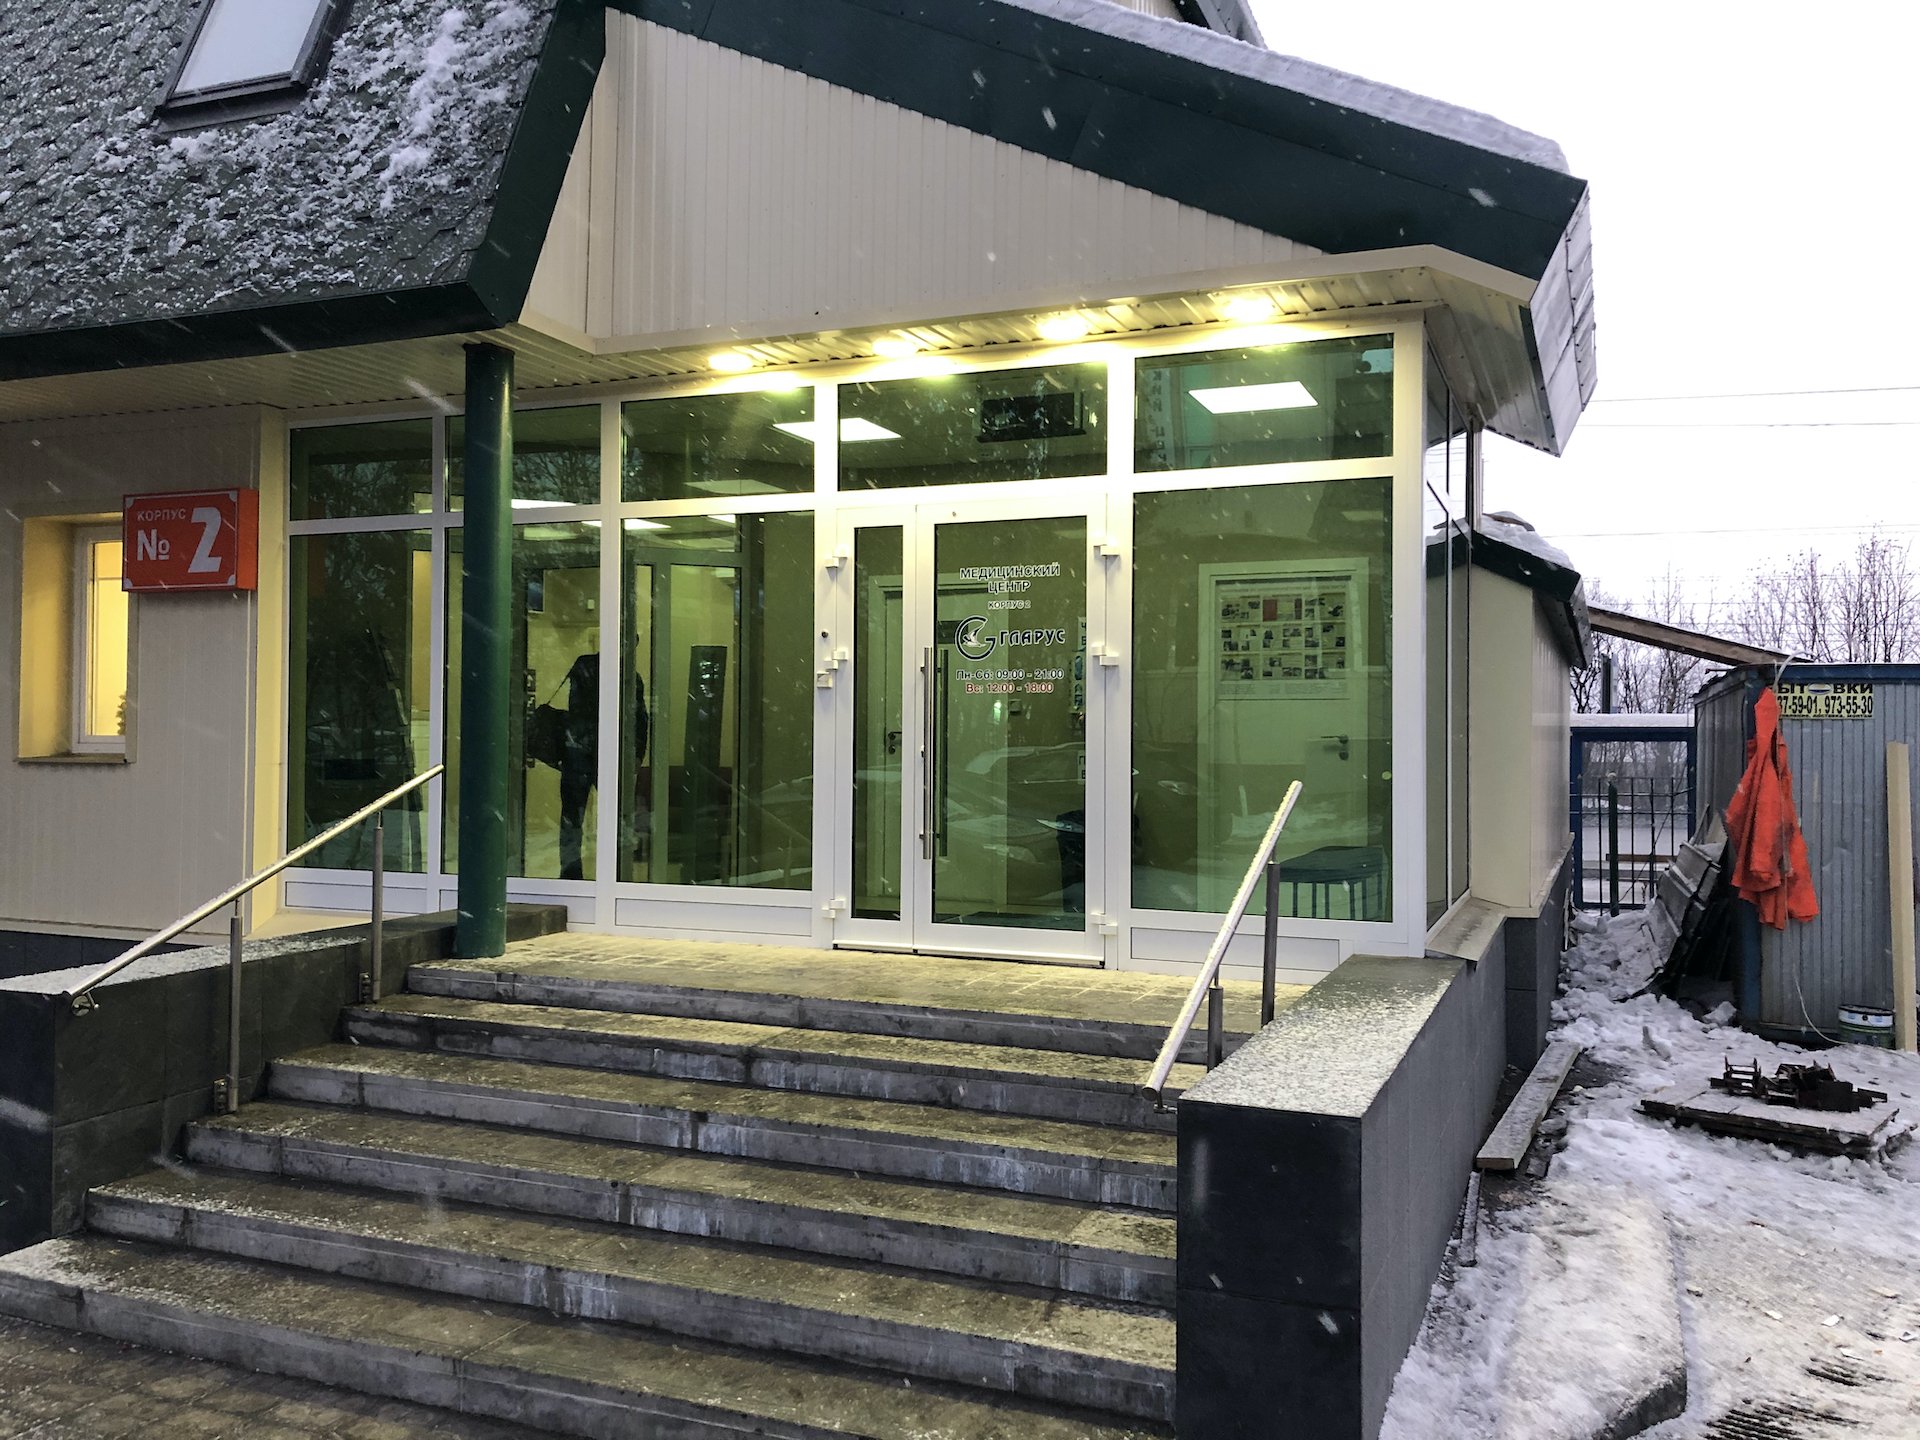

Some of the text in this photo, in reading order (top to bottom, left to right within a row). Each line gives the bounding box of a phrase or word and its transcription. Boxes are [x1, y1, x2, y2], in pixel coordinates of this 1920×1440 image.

[137, 508, 187, 522] КОРПУС
[136, 506, 222, 574] № 2
[960, 562, 1061, 580] МЕДИЦИНСКИЙ
[988, 580, 1031, 595] ЦЕНТР
[988, 600, 1032, 610] КОРПУС 2
[999, 629, 1066, 646] ГЛАРУС
[956, 669, 994, 680] Пн-Сб:
[995, 669, 1025, 680] 09:00
[1034, 668, 1064, 680] 21:00
[965, 683, 984, 693] Вс:
[986, 683, 1015, 693] 12:00
[1024, 682, 1054, 693] 18:00
[1777, 695, 1873, 714] 37-59-01, 973-55-30
